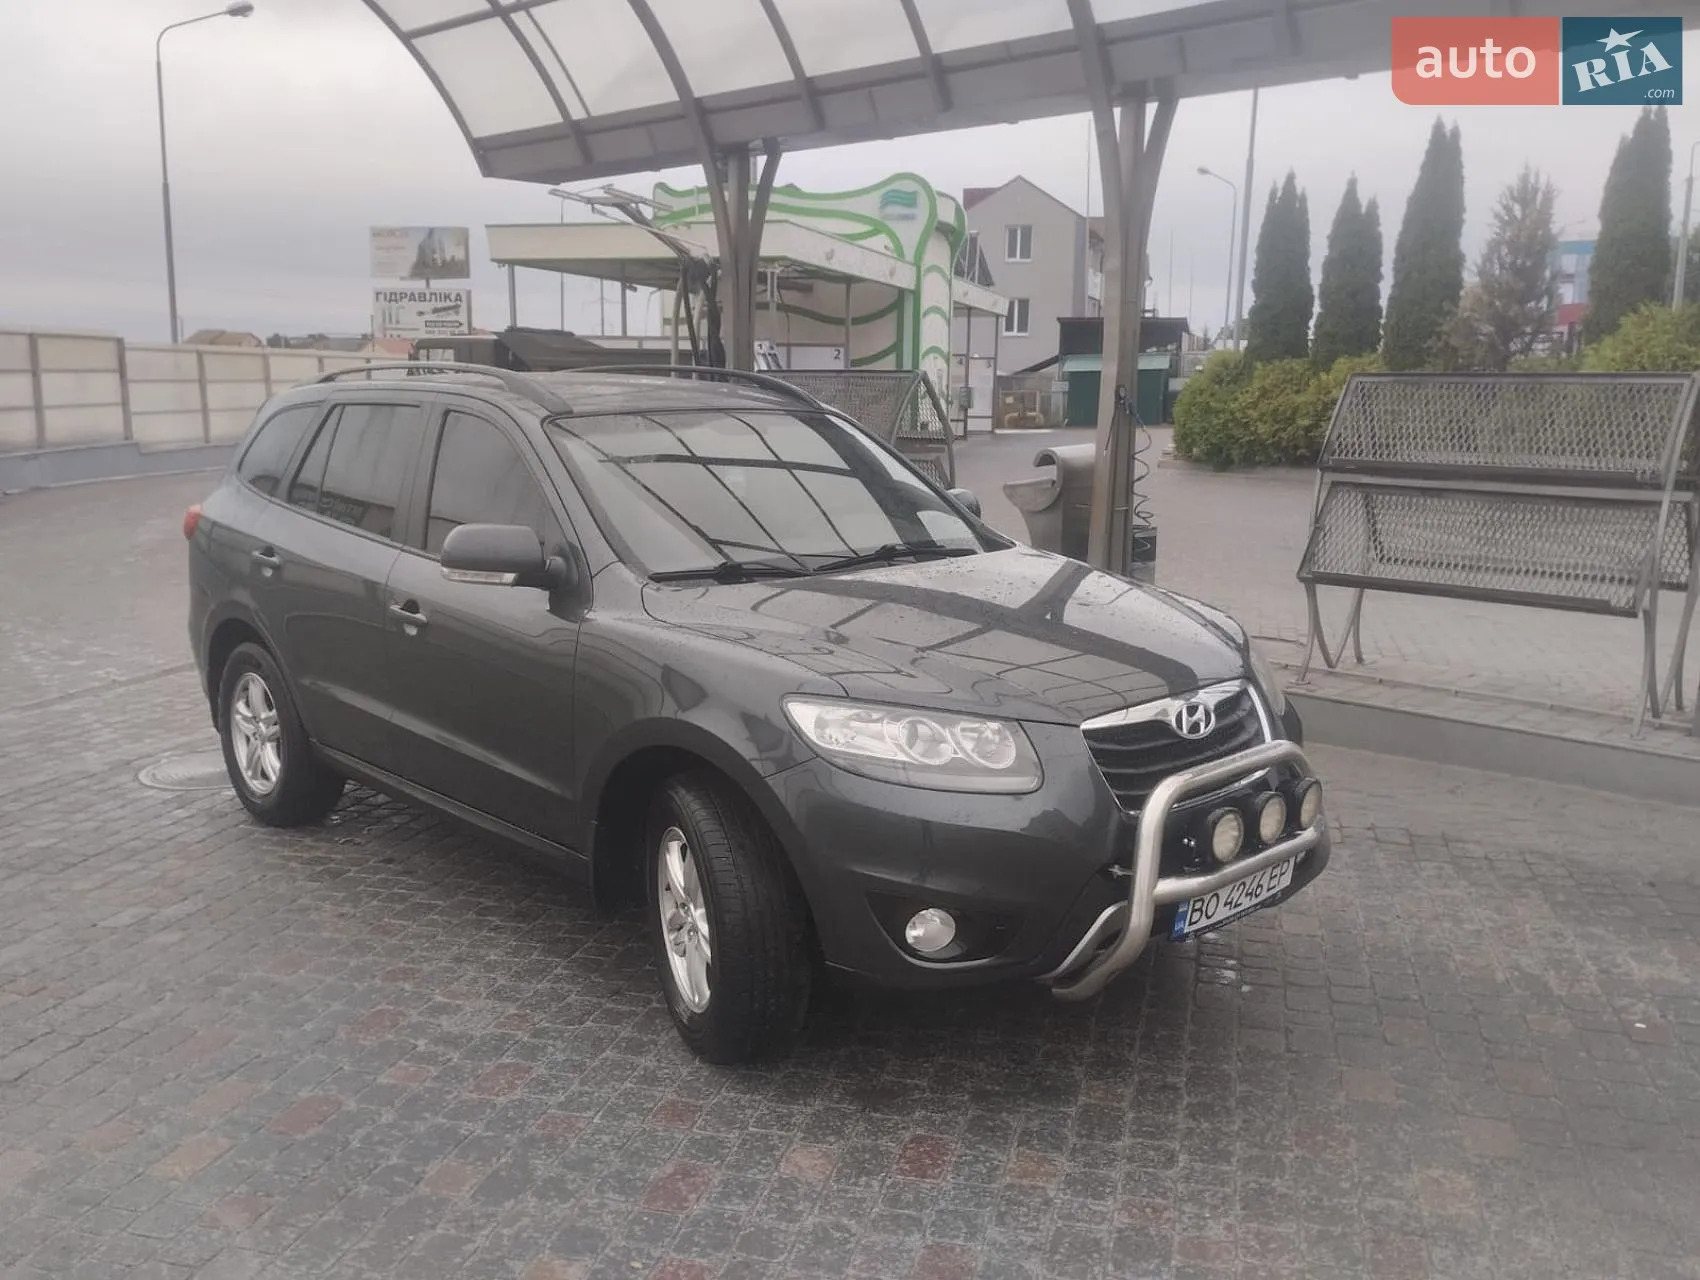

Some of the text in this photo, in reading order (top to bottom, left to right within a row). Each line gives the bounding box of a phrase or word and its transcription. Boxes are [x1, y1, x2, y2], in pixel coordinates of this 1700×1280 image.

[375, 292, 463, 304] ГІДРАВЛІКА
[834, 349, 841, 360] 2
[1188, 859, 1290, 926] BO 4246 EP
